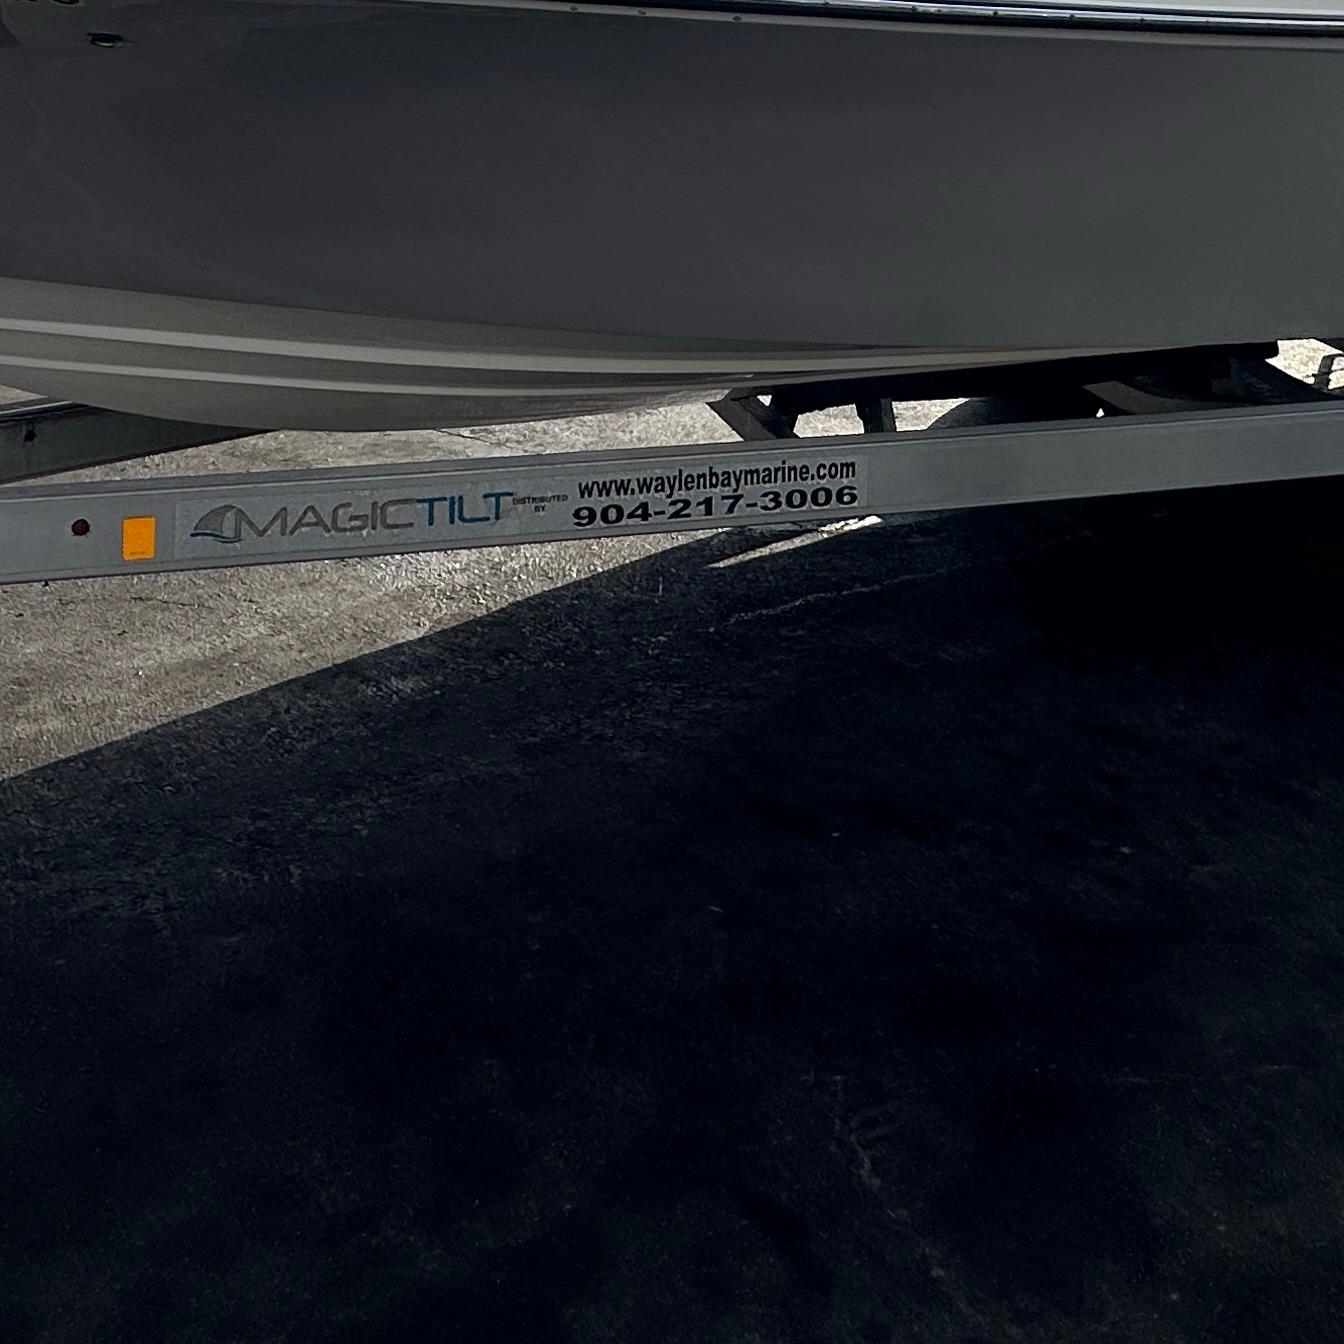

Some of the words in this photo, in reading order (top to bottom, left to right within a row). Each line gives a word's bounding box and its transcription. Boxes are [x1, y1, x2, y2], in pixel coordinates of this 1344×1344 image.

[579, 460, 856, 499] www.waylenbaymarine.com
[513, 495, 568, 505] DISTRIBUTED
[572, 485, 858, 527] 904-217-3006
